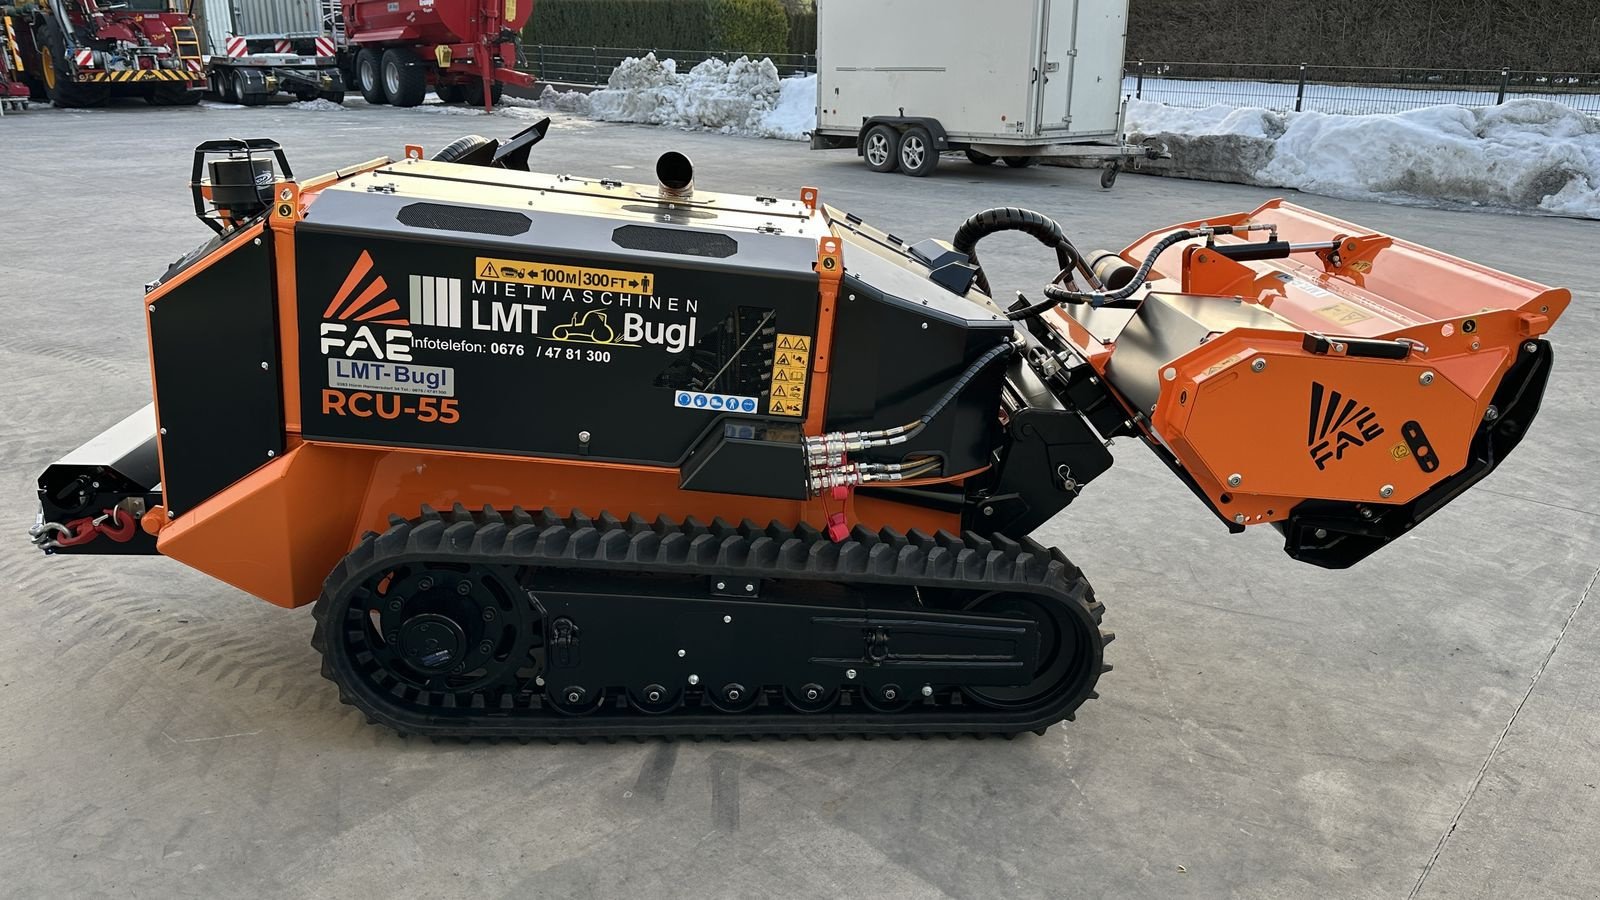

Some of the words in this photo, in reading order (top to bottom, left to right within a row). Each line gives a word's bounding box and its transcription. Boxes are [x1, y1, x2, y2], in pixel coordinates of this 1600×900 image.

[471, 279, 698, 313] MIETMASCHINEN
[320, 322, 413, 362] FAE
[472, 299, 547, 335] LMT
[623, 312, 697, 354] Bugl
[411, 336, 486, 354] Infotelefon:
[490, 342, 525, 357] 0676
[545, 345, 561, 359] 47
[566, 347, 581, 361] 81
[586, 349, 611, 363] 300
[336, 360, 447, 389] LMT-Bugl
[322, 388, 460, 424] RCU-55
[1309, 411, 1385, 471] FAE
